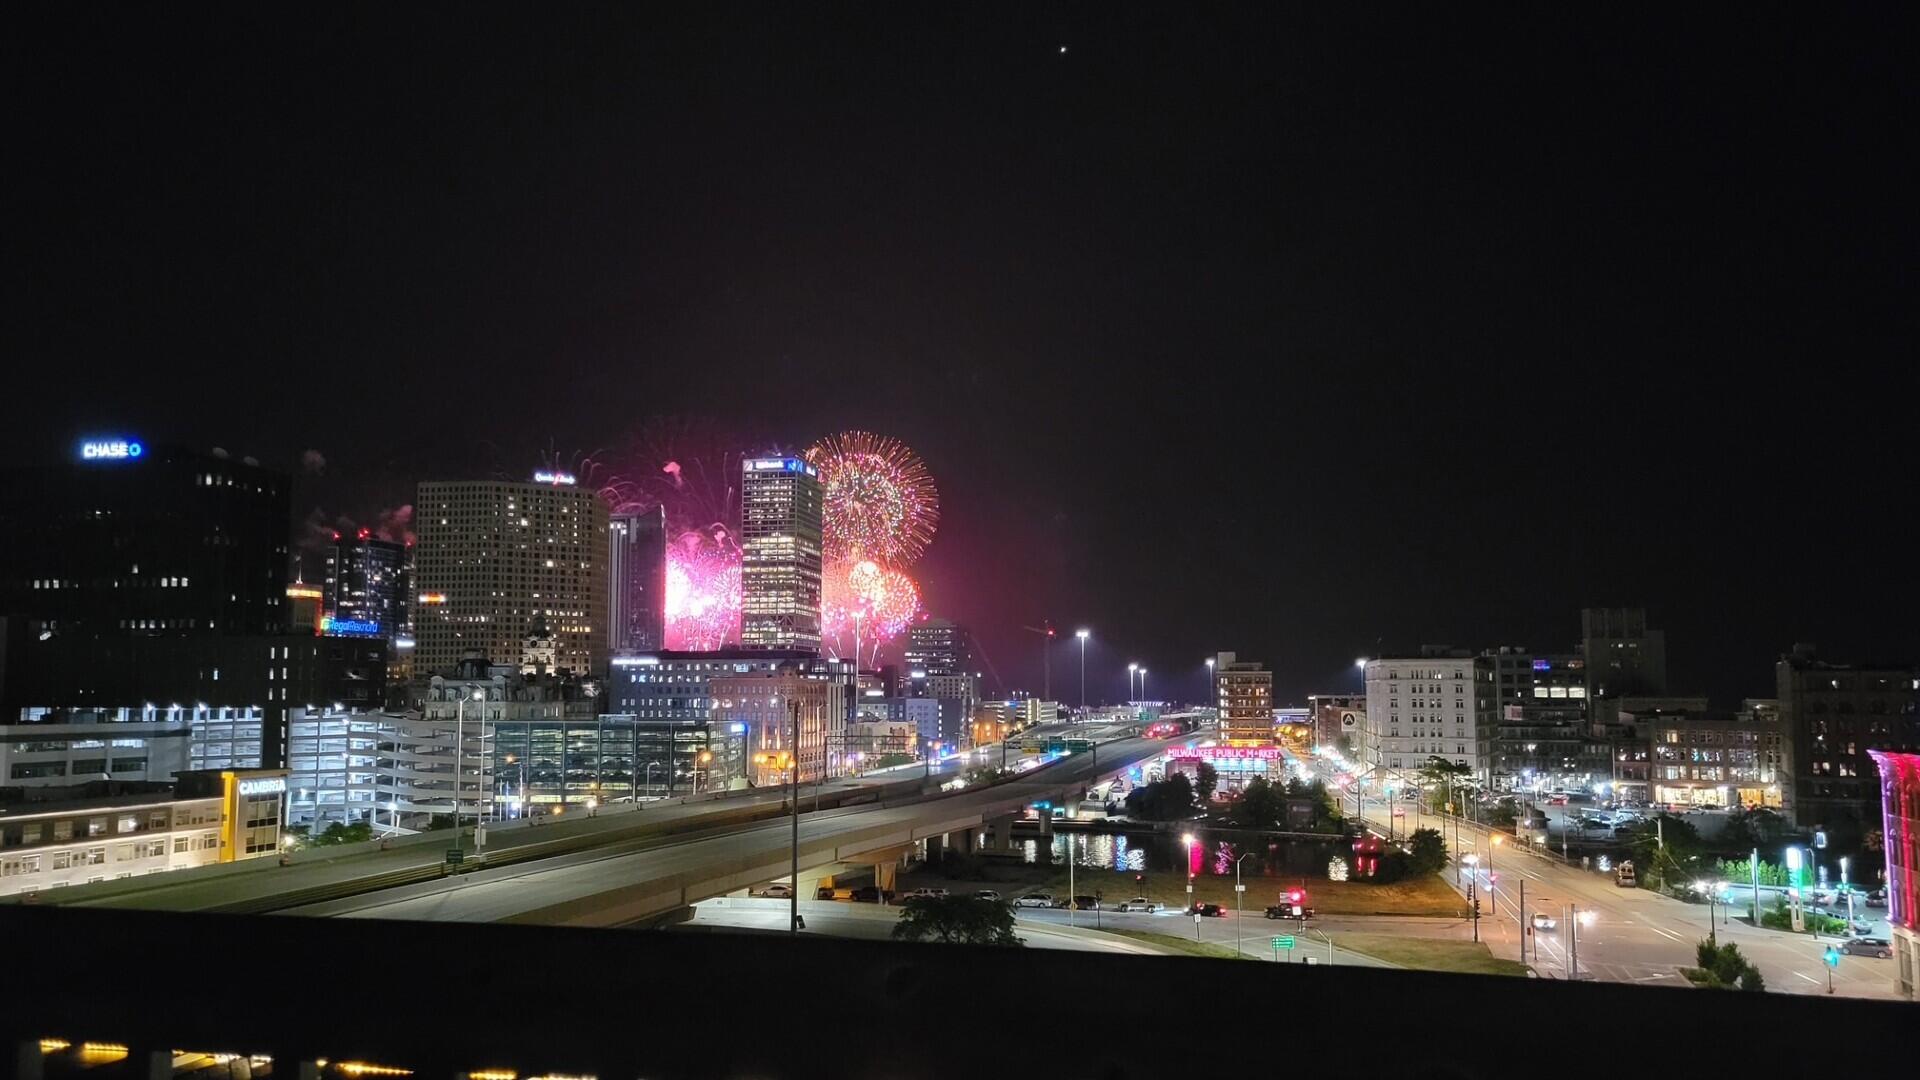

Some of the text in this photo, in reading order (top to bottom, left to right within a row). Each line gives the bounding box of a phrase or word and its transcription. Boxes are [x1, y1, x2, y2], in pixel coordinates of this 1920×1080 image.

[84, 442, 128, 458] CHASE
[1167, 748, 1213, 758] MILWAUKEE
[1216, 749, 1244, 758] PUBLIC
